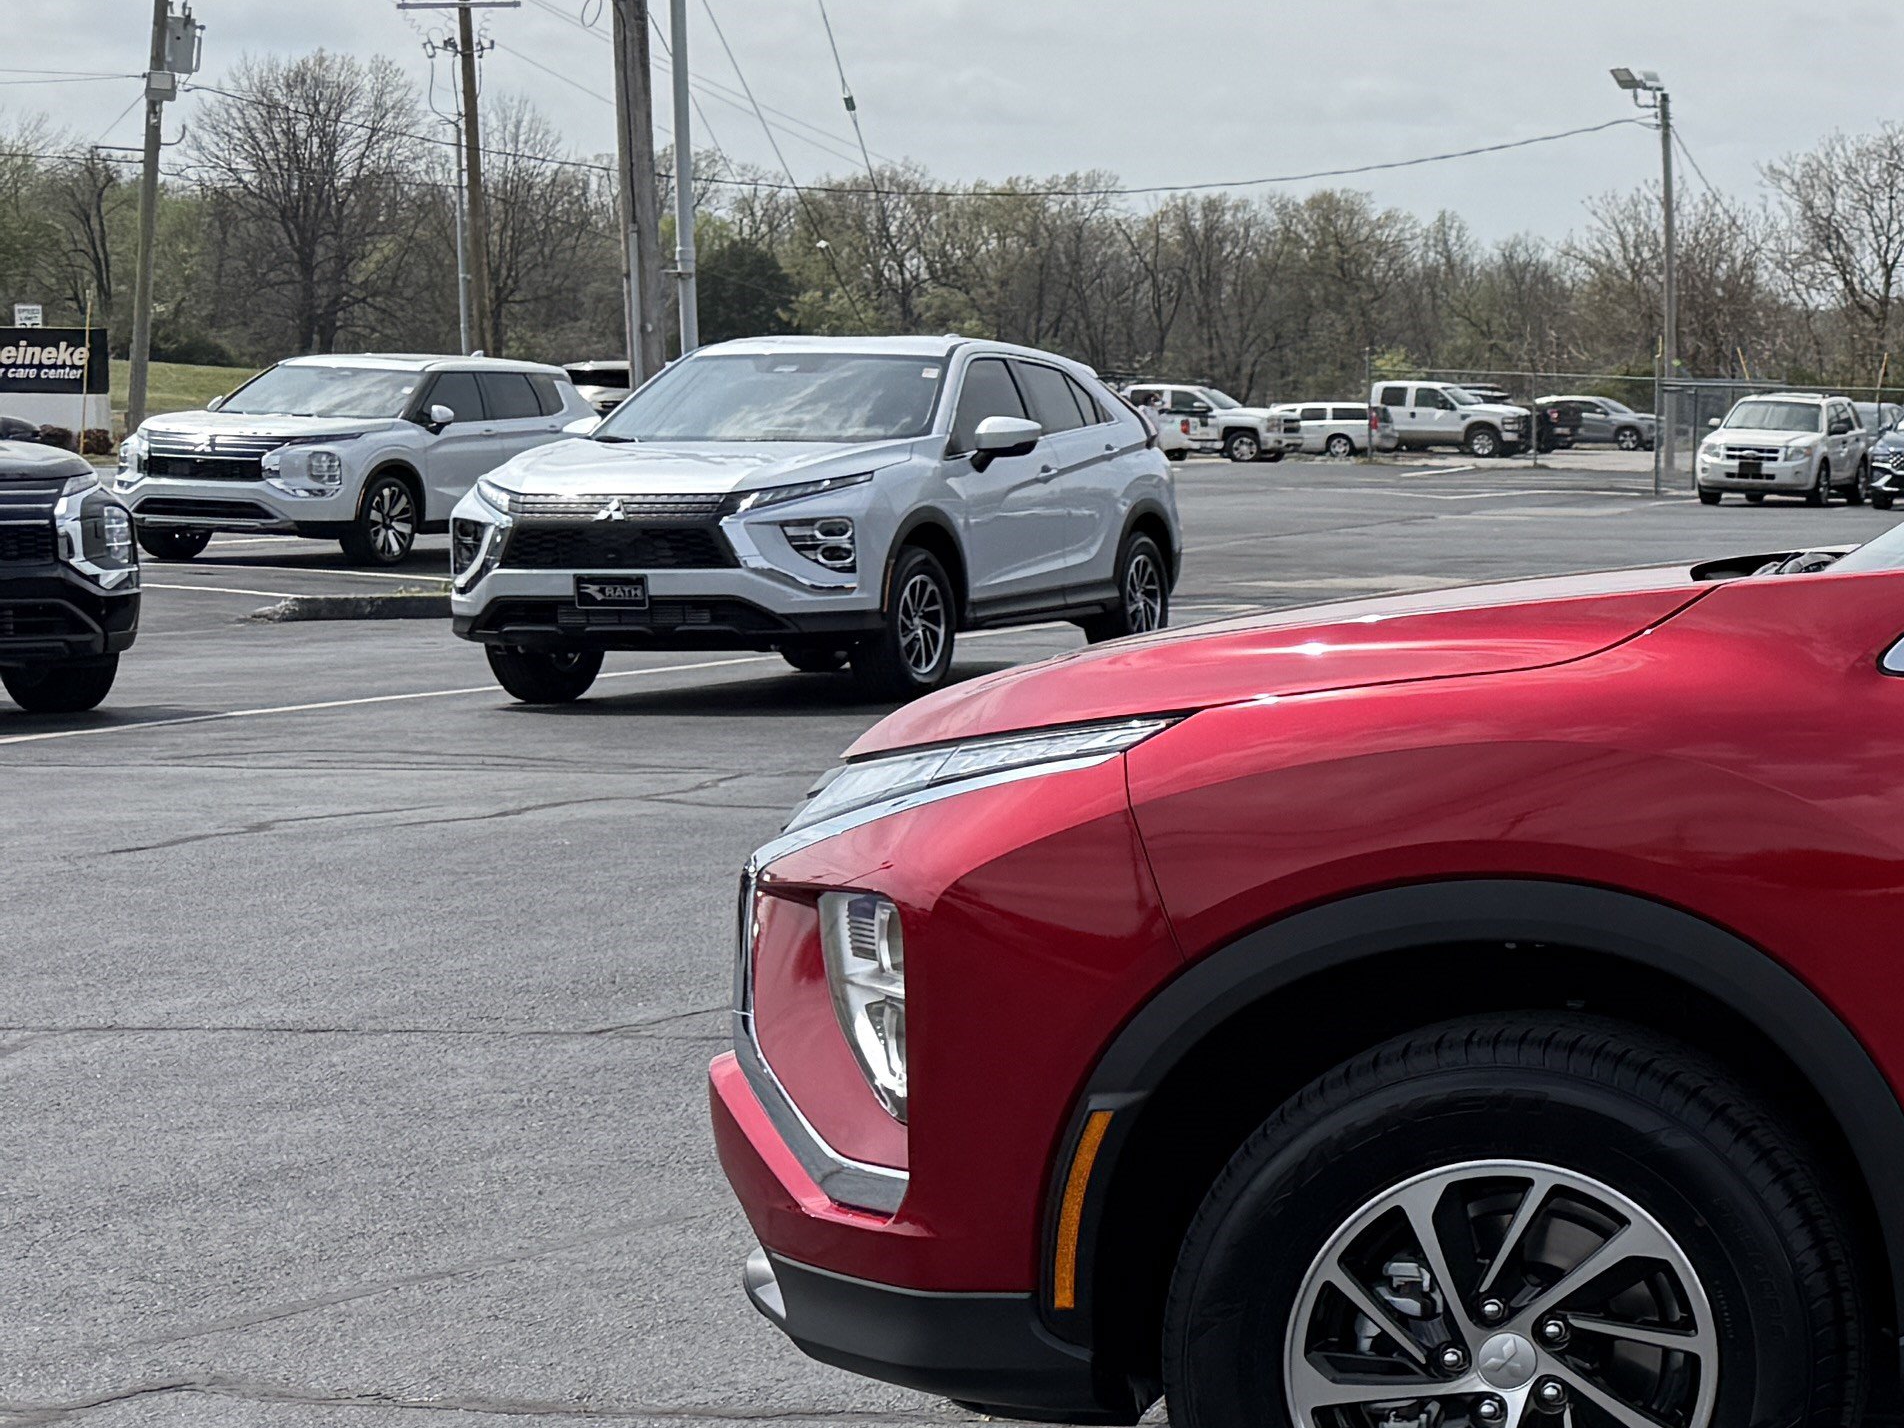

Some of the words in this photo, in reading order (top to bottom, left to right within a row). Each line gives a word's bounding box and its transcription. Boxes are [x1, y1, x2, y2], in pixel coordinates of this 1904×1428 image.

[8, 368, 37, 378] care
[41, 367, 82, 379] center
[605, 585, 643, 598] RATH
